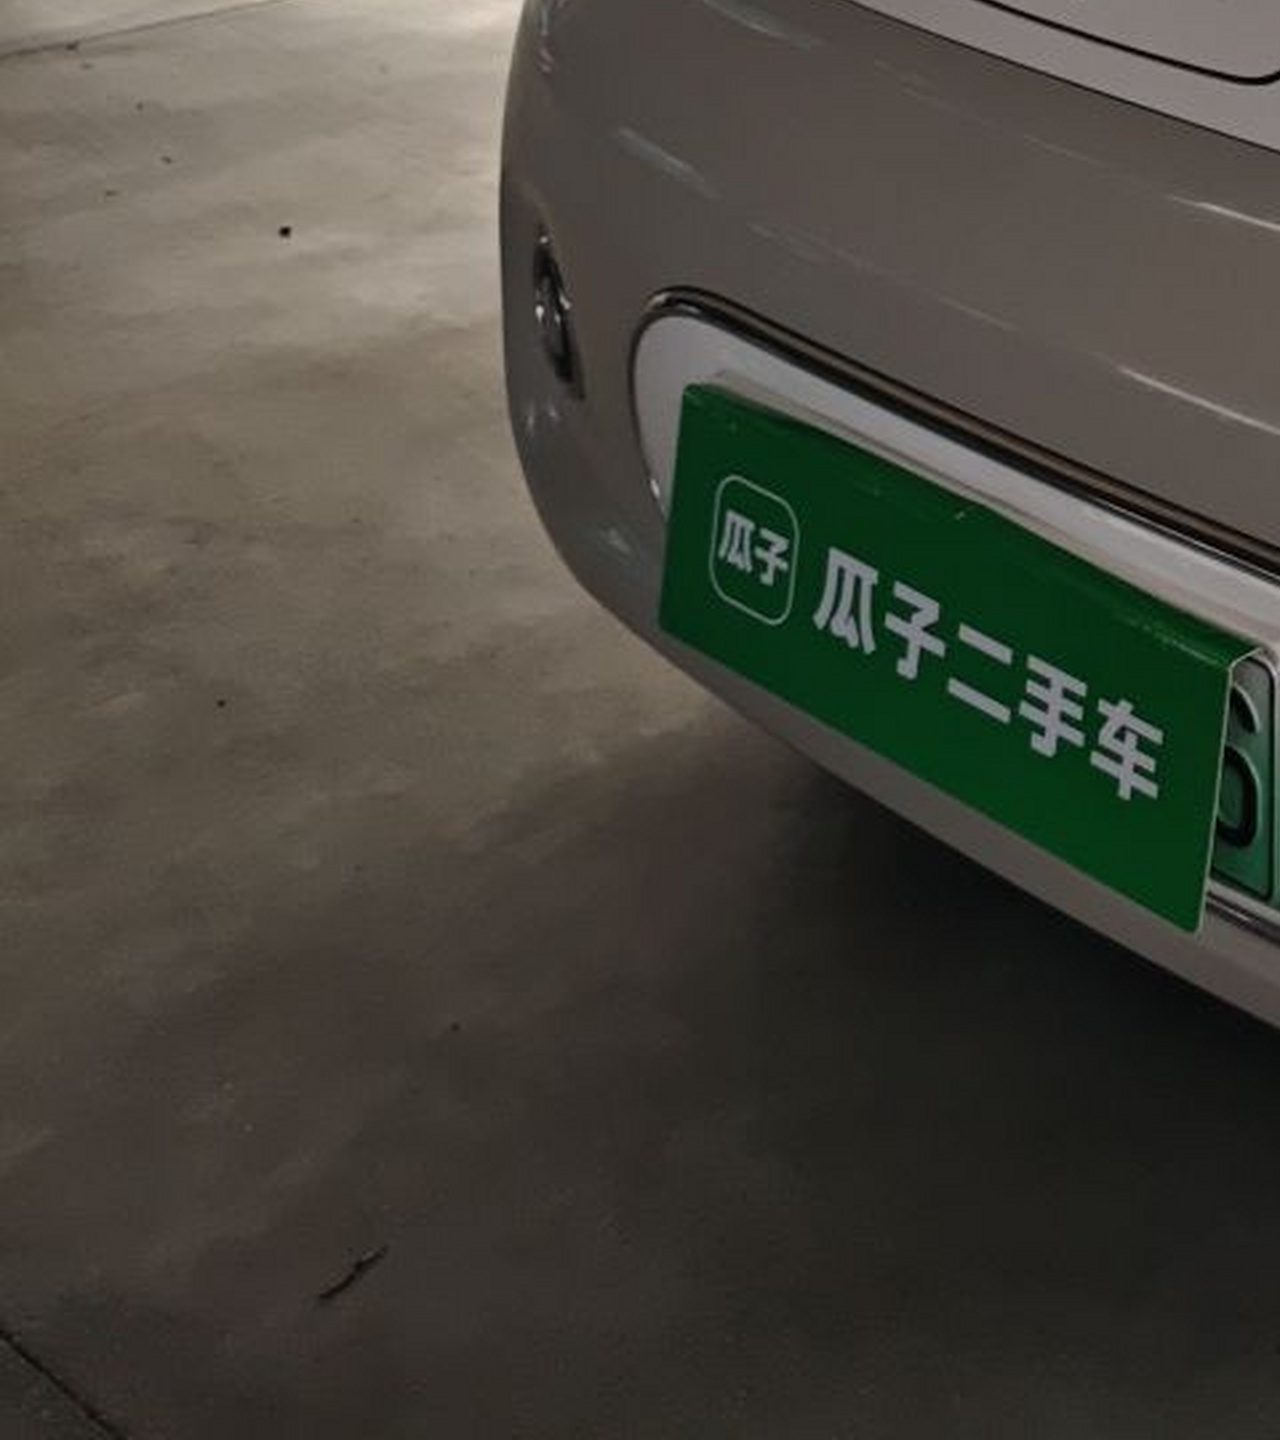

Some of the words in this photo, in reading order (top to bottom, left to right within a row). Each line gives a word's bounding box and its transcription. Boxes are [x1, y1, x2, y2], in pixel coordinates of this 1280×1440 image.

[718, 509, 790, 586] 瓜子
[812, 546, 1164, 801] 瓜子二手车
